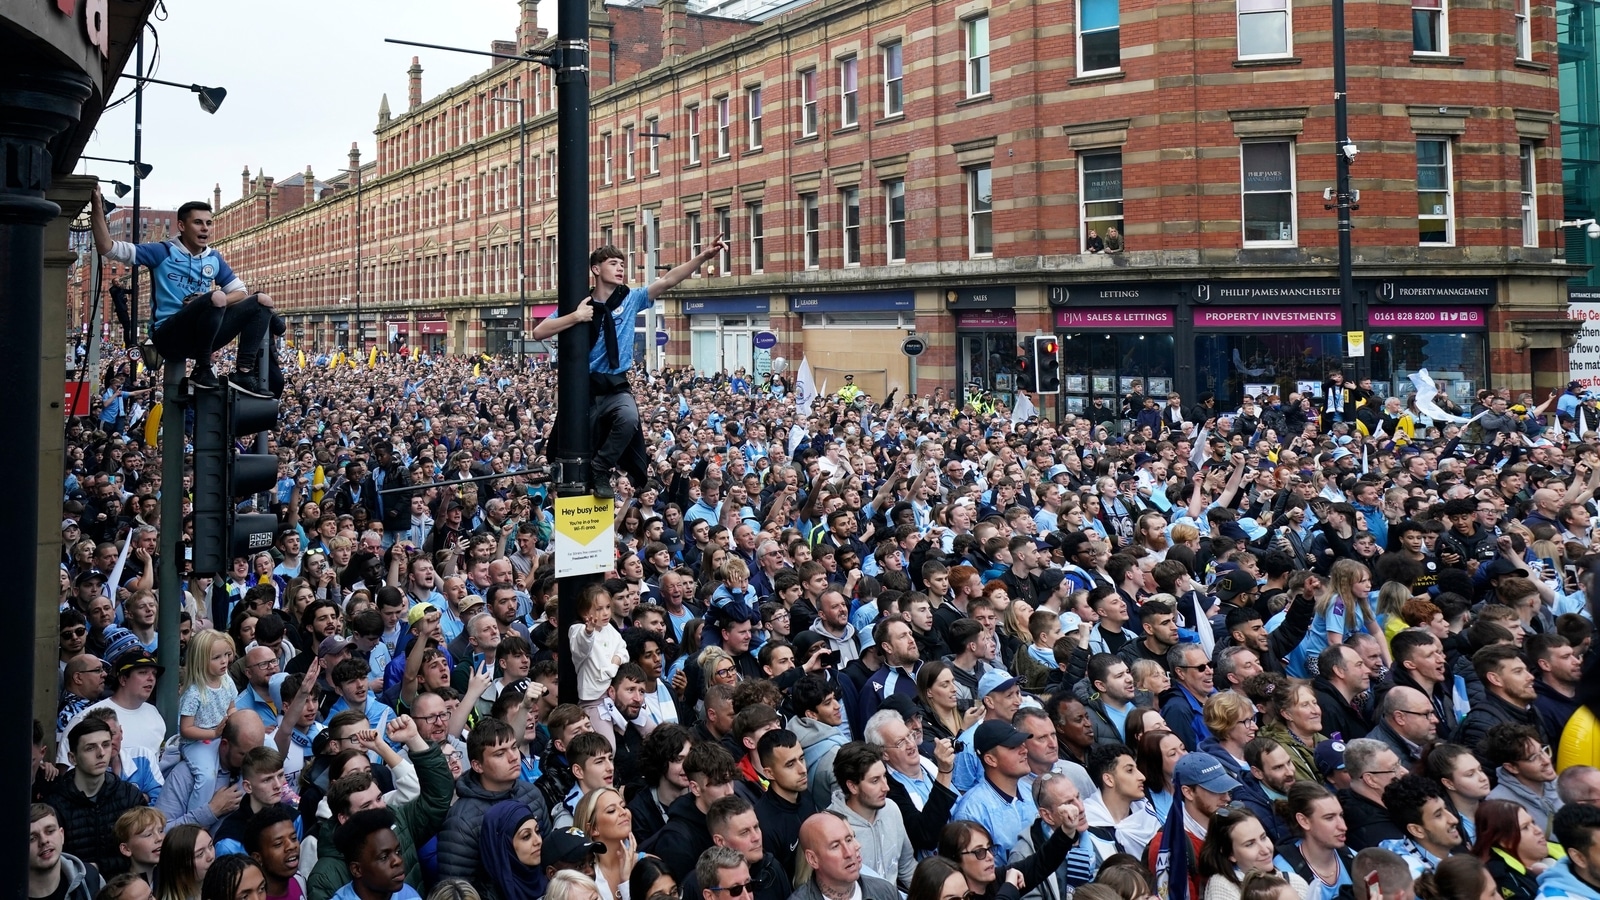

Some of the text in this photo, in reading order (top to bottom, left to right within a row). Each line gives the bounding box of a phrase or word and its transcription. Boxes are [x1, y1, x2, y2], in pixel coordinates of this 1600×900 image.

[1251, 288, 1279, 298] JAMES
[1400, 288, 1436, 296] PROPERTY
[1064, 313, 1082, 324] PJM
[1206, 312, 1336, 320] PROPERTY INVESTMENTS
[1374, 312, 1434, 320] 0161 828 8200
[1572, 310, 1587, 320] Life
[1576, 342, 1593, 353] flow
[1570, 360, 1583, 370] the
